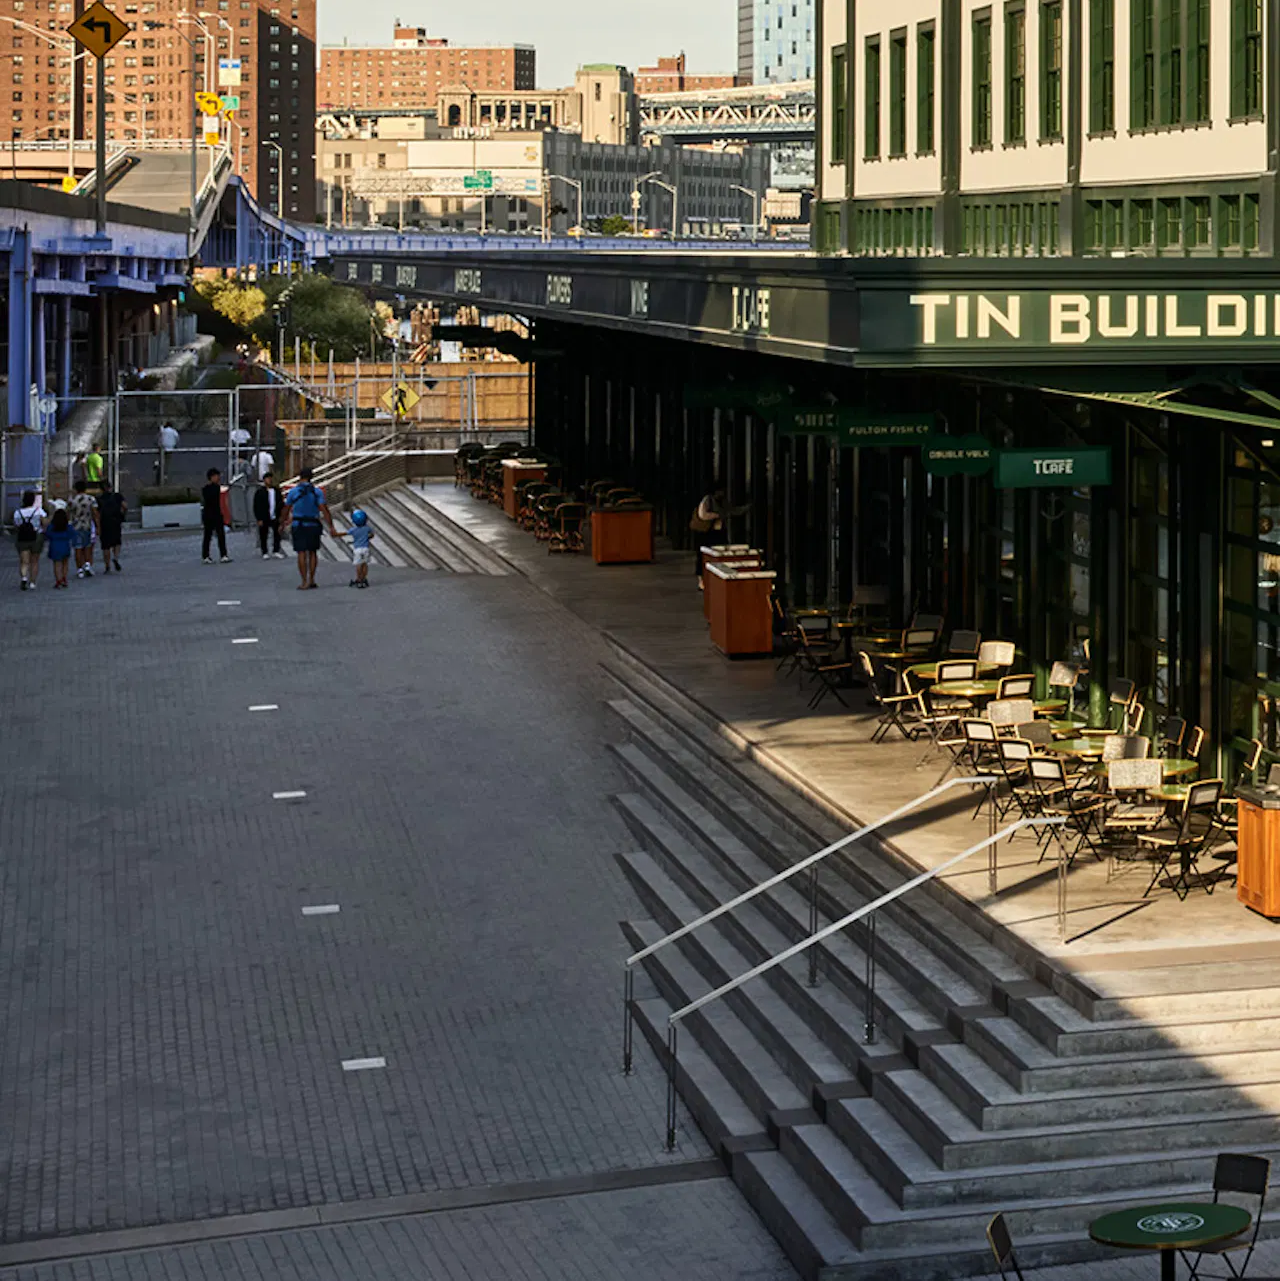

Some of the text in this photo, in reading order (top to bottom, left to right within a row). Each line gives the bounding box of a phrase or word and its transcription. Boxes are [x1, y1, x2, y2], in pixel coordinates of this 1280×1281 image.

[742, 287, 771, 330] CAFE
[909, 294, 1021, 344] TIN
[849, 425, 889, 436] FULTON
[890, 424, 915, 435] FISH
[928, 449, 990, 460] DOUBLE YOLK
